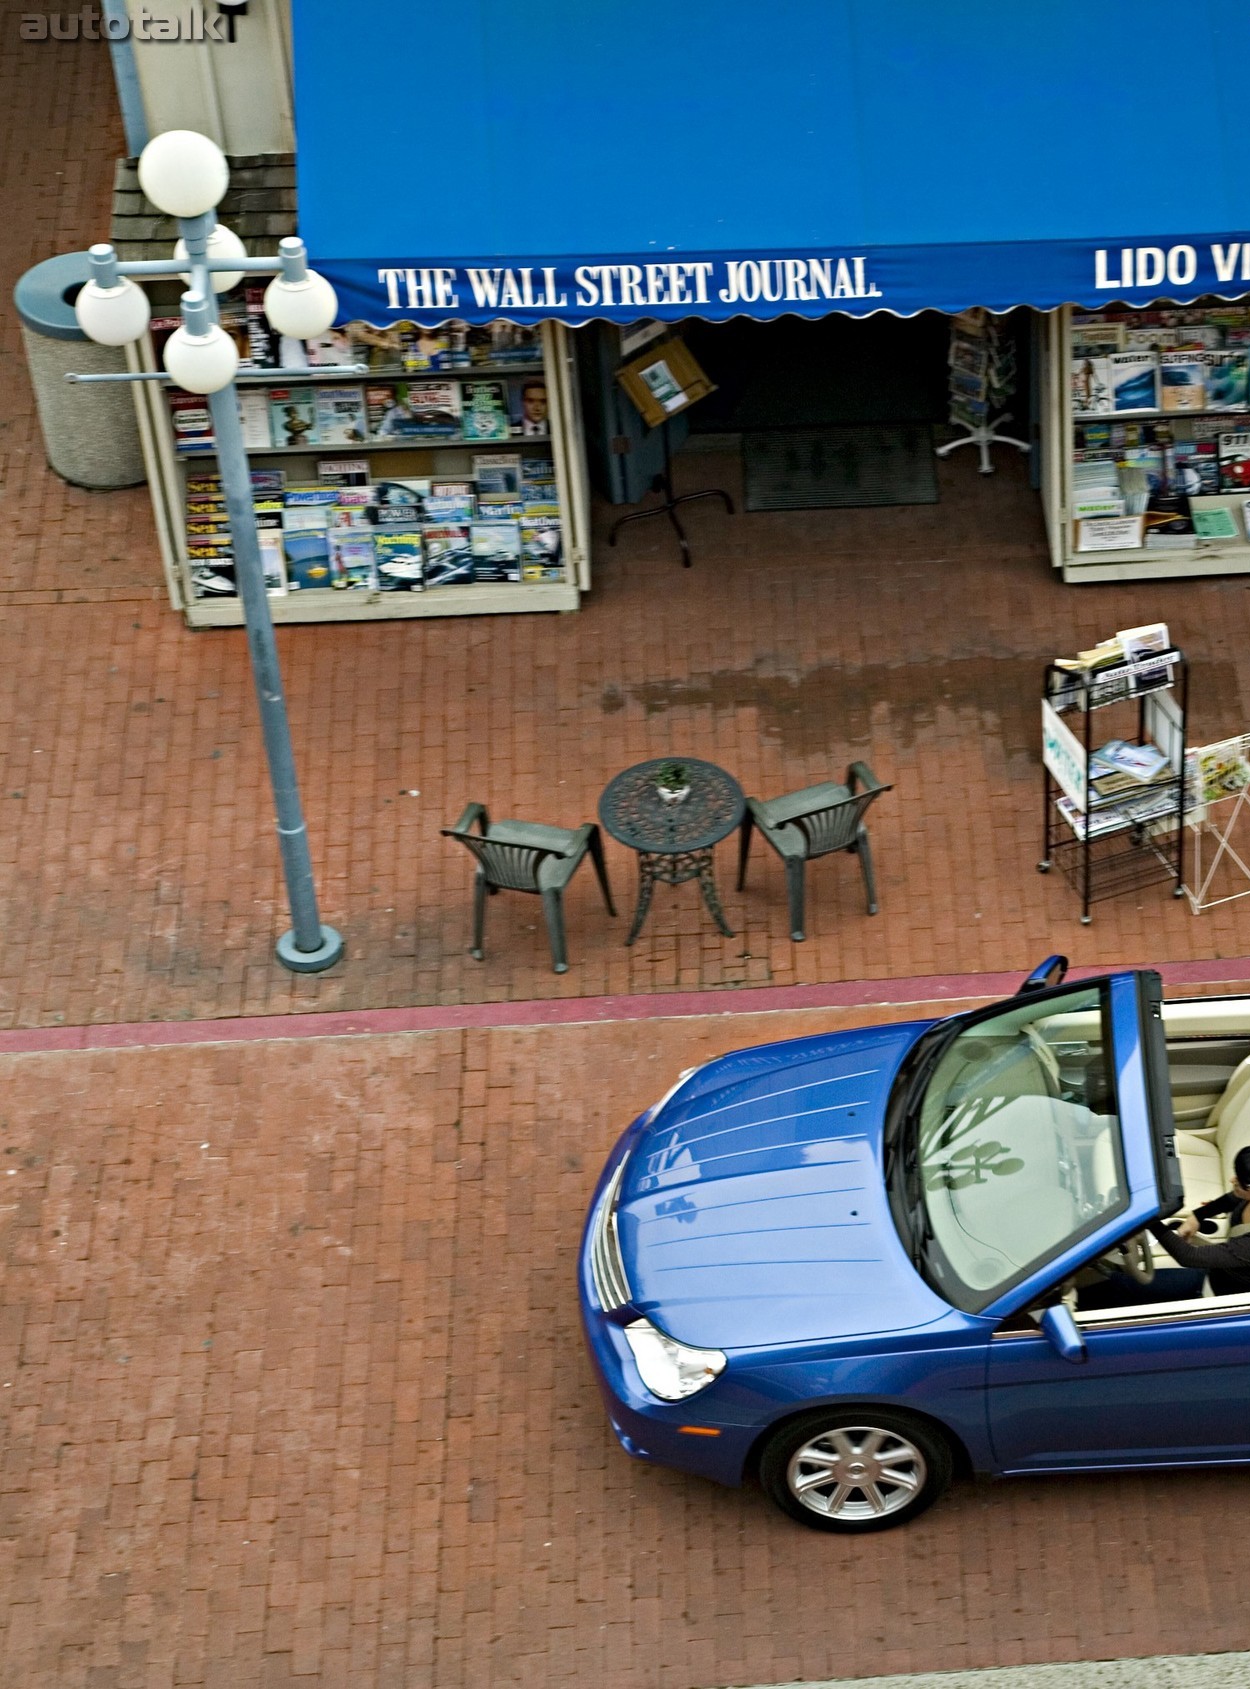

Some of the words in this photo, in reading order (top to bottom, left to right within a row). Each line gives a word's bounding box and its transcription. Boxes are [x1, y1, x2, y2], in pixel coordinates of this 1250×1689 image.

[378, 267, 458, 309] THE
[463, 266, 567, 308] WALL
[575, 262, 714, 306] STREET
[1094, 244, 1198, 289] LIDO
[1224, 434, 1250, 445] 911
